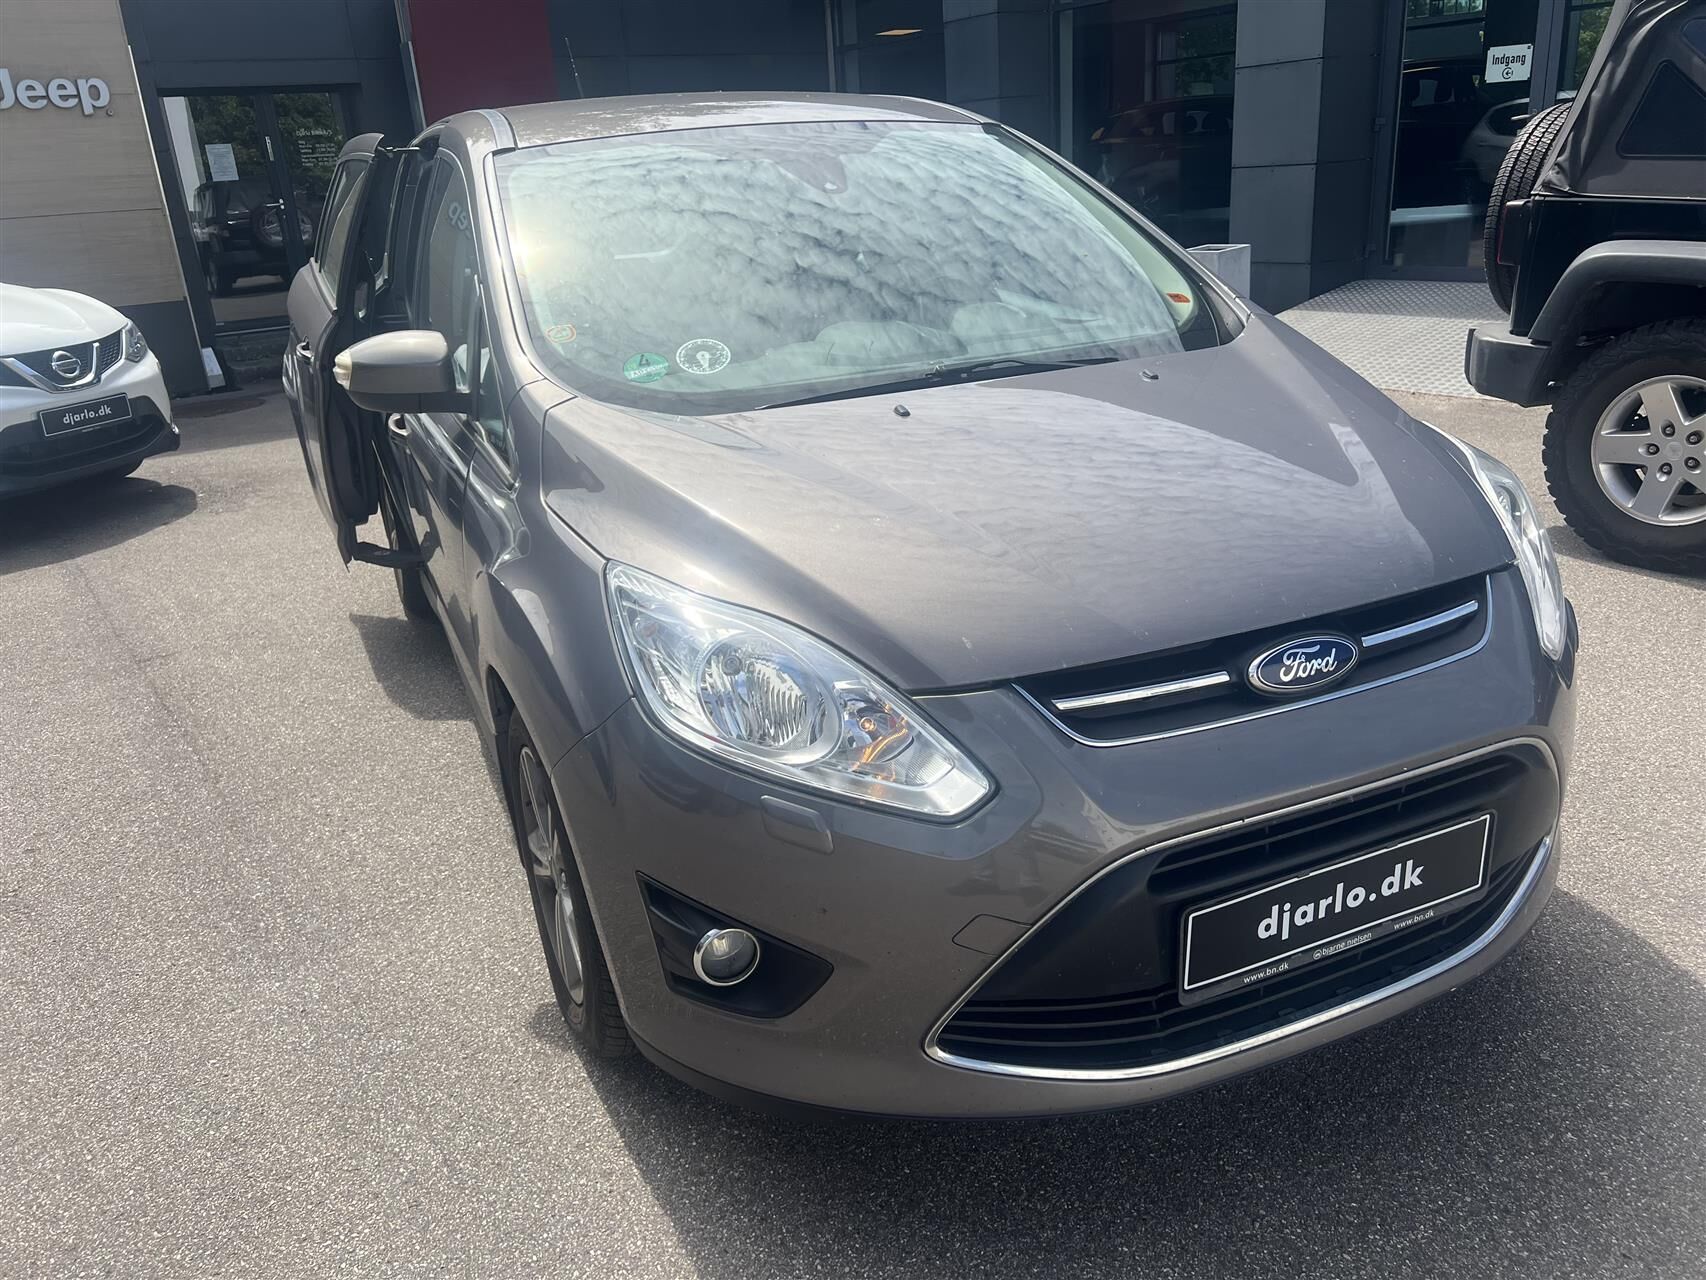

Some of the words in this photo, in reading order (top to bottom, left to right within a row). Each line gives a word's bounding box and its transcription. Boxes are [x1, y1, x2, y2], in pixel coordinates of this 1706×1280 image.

[1492, 53, 1526, 66] Indgang
[0, 68, 110, 115] Jeep
[63, 404, 112, 425] djarlo.dk
[1280, 644, 1338, 682] Ford
[1257, 859, 1425, 941] djarlo.dk
[1393, 909, 1435, 930] www.bn.dk
[1322, 940, 1346, 956] bjarne
[1346, 932, 1372, 946] nielsen
[1243, 961, 1289, 984] www.bn.dk
